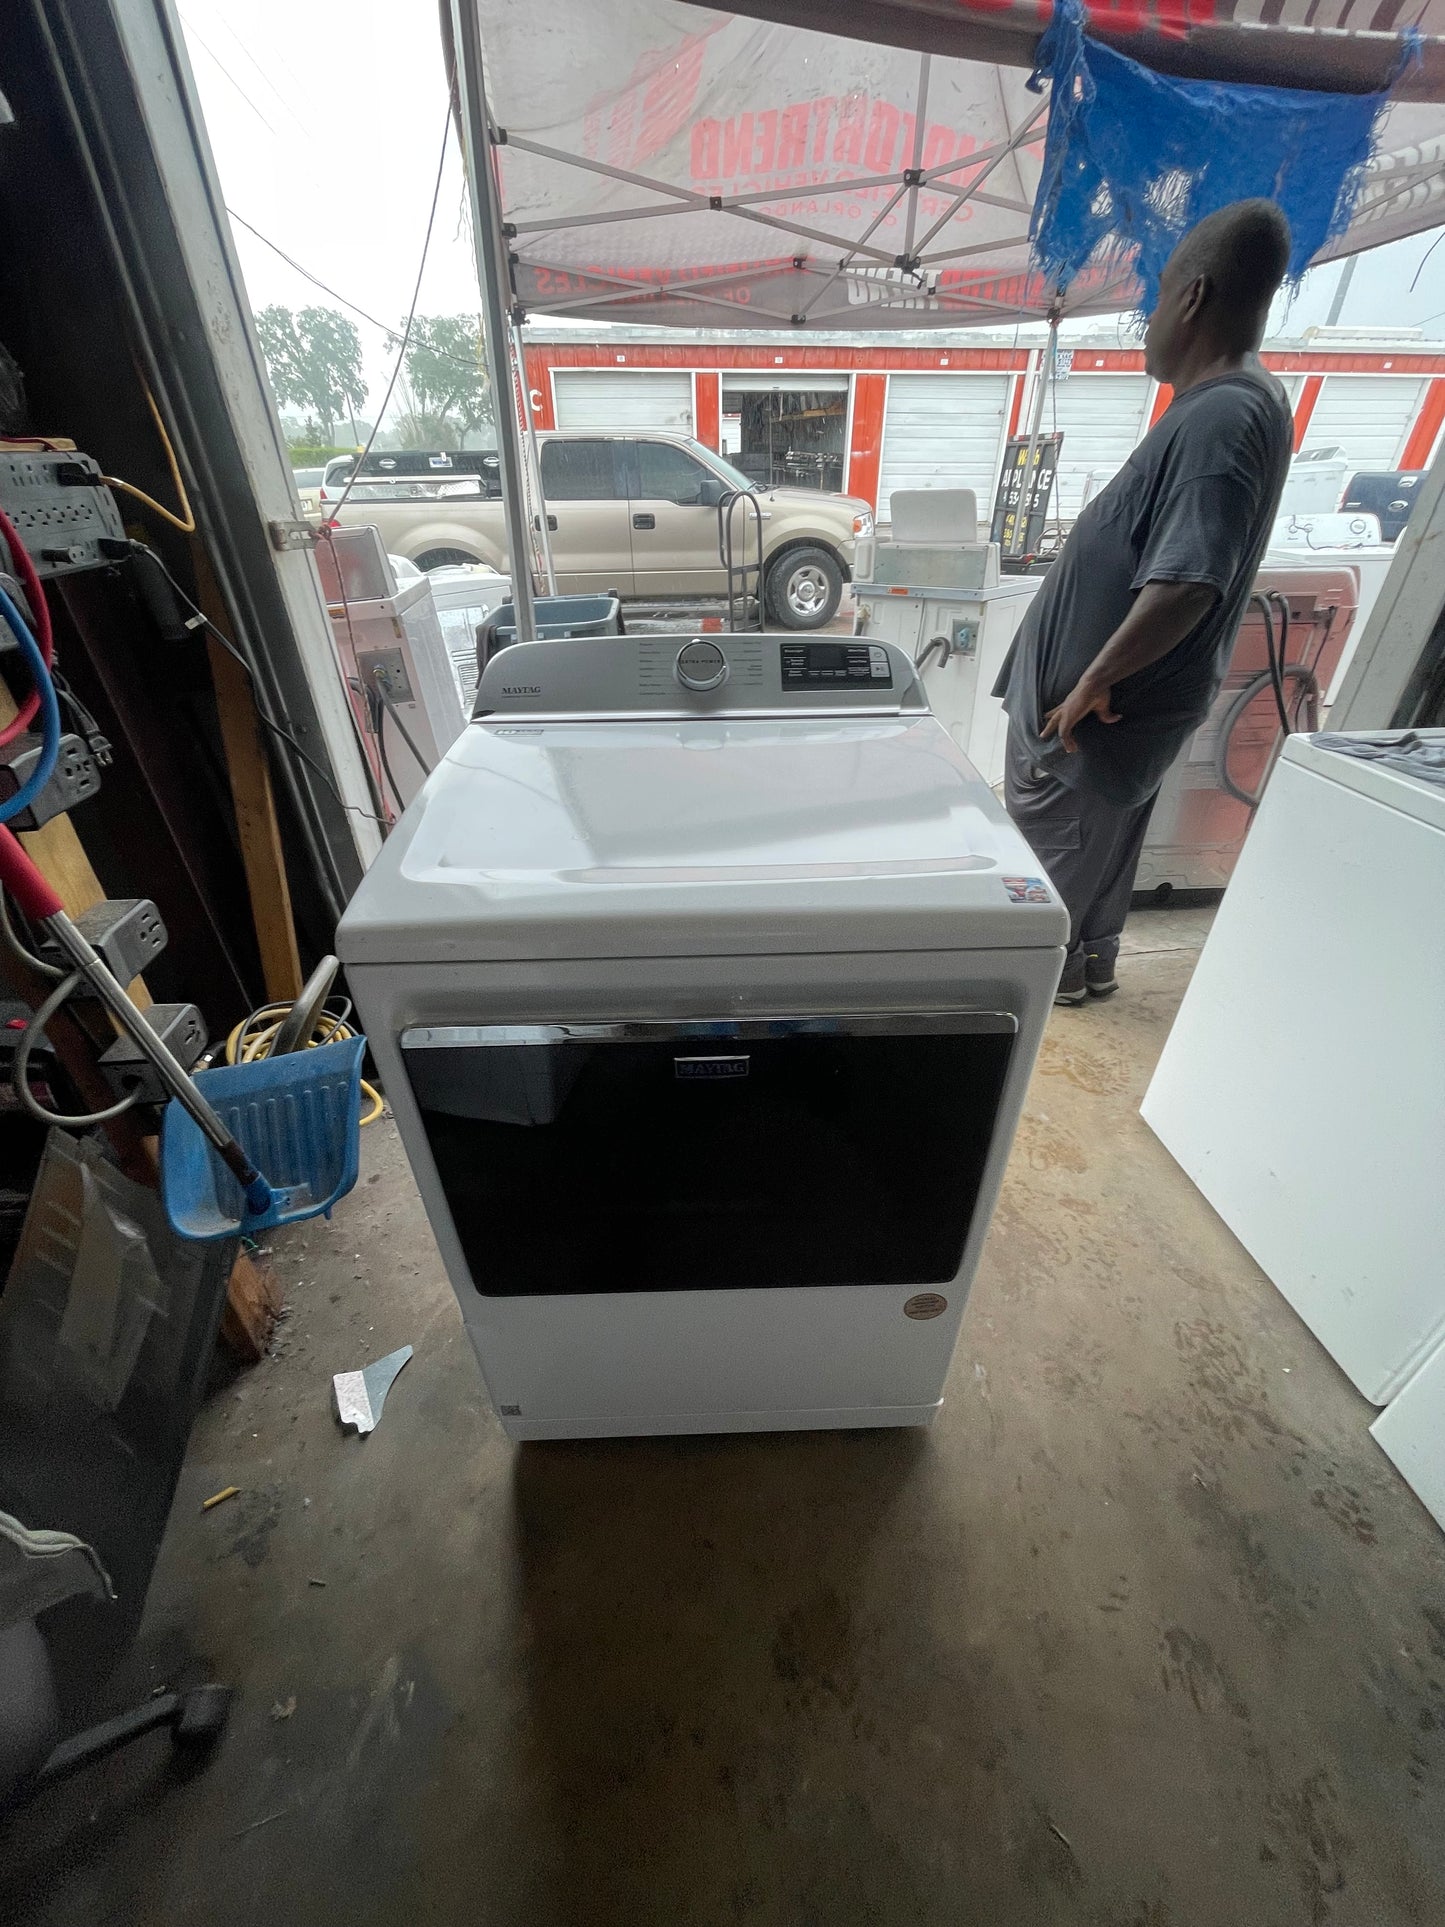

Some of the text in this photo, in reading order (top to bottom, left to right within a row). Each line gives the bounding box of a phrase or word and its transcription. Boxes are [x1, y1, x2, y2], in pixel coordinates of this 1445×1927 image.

[1017, 447, 1041, 466] Wb
[502, 686, 541, 695] MAYTAG
[680, 1062, 745, 1075] MAYTAG
